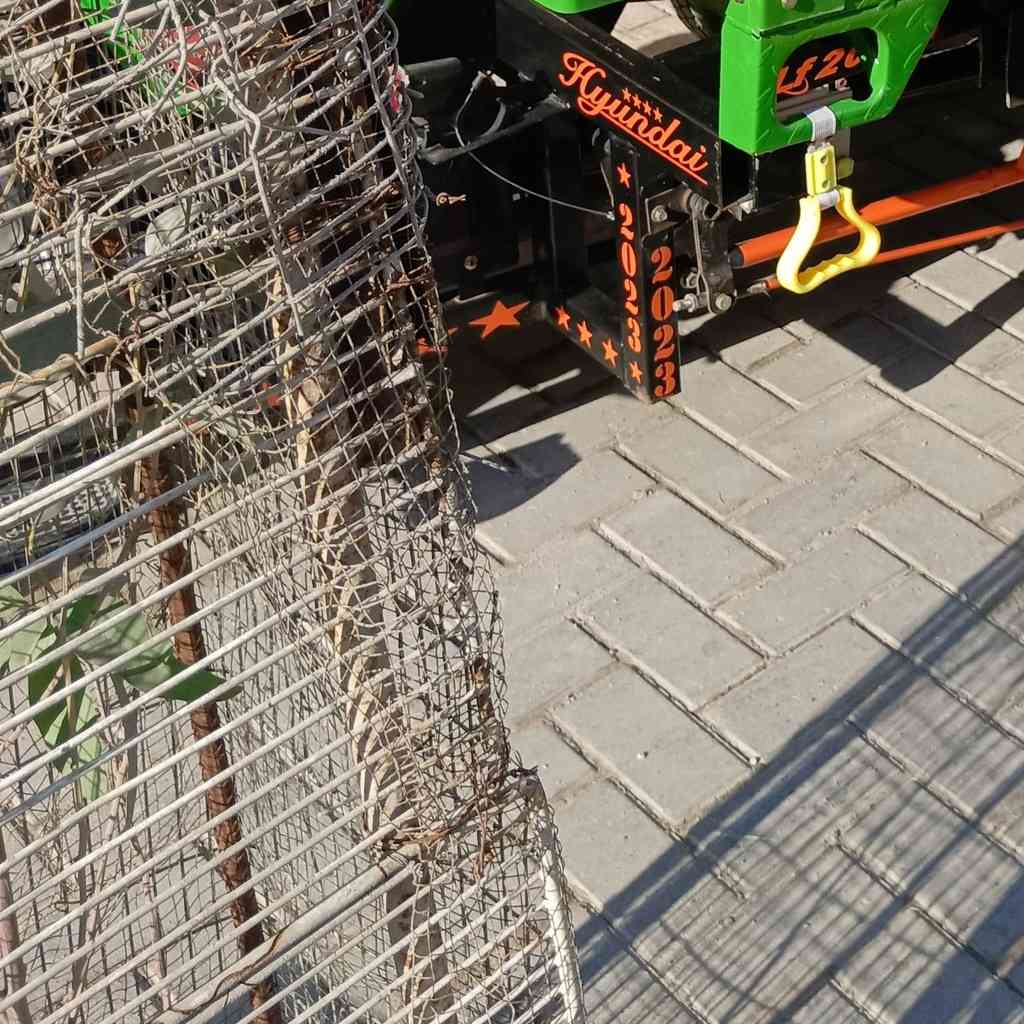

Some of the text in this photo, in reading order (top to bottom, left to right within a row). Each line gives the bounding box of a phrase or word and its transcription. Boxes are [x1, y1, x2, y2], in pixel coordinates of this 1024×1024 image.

[558, 50, 710, 179] Hyundai
[617, 202, 643, 354] 2023
[650, 245, 677, 399] 2023
